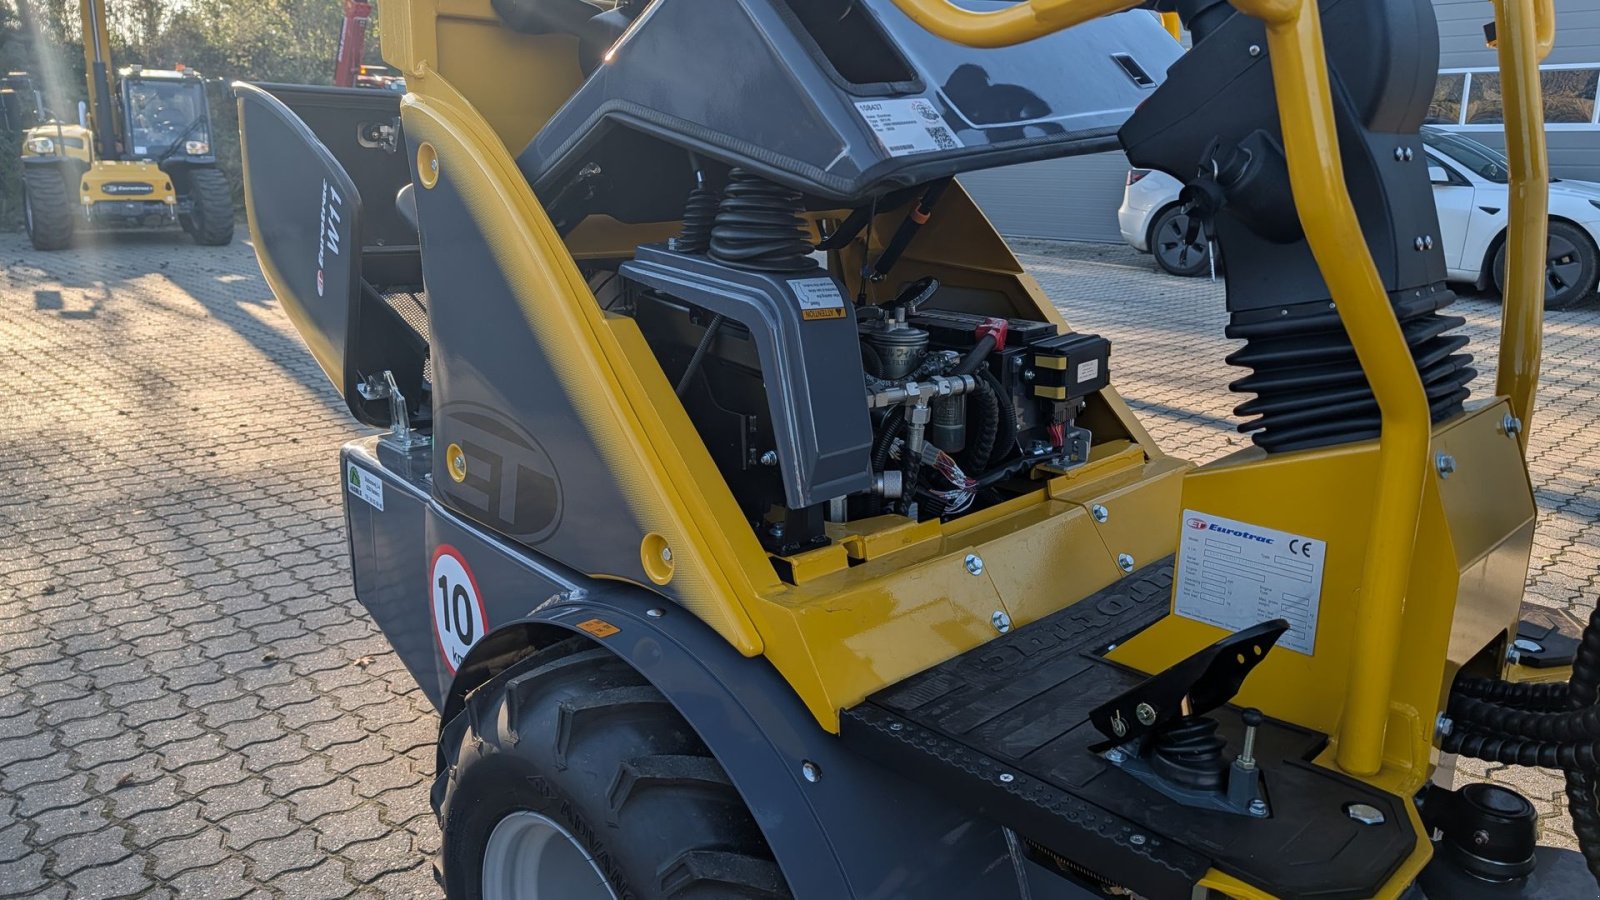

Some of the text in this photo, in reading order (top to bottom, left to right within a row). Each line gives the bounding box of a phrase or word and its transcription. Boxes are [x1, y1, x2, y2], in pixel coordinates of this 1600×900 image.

[318, 178, 328, 269] Eurotrac
[326, 185, 342, 255] W11
[804, 309, 834, 318] ATTENTION
[1208, 523, 1275, 545] Eurotrac
[1288, 539, 1312, 559] CE
[437, 574, 474, 647] 10
